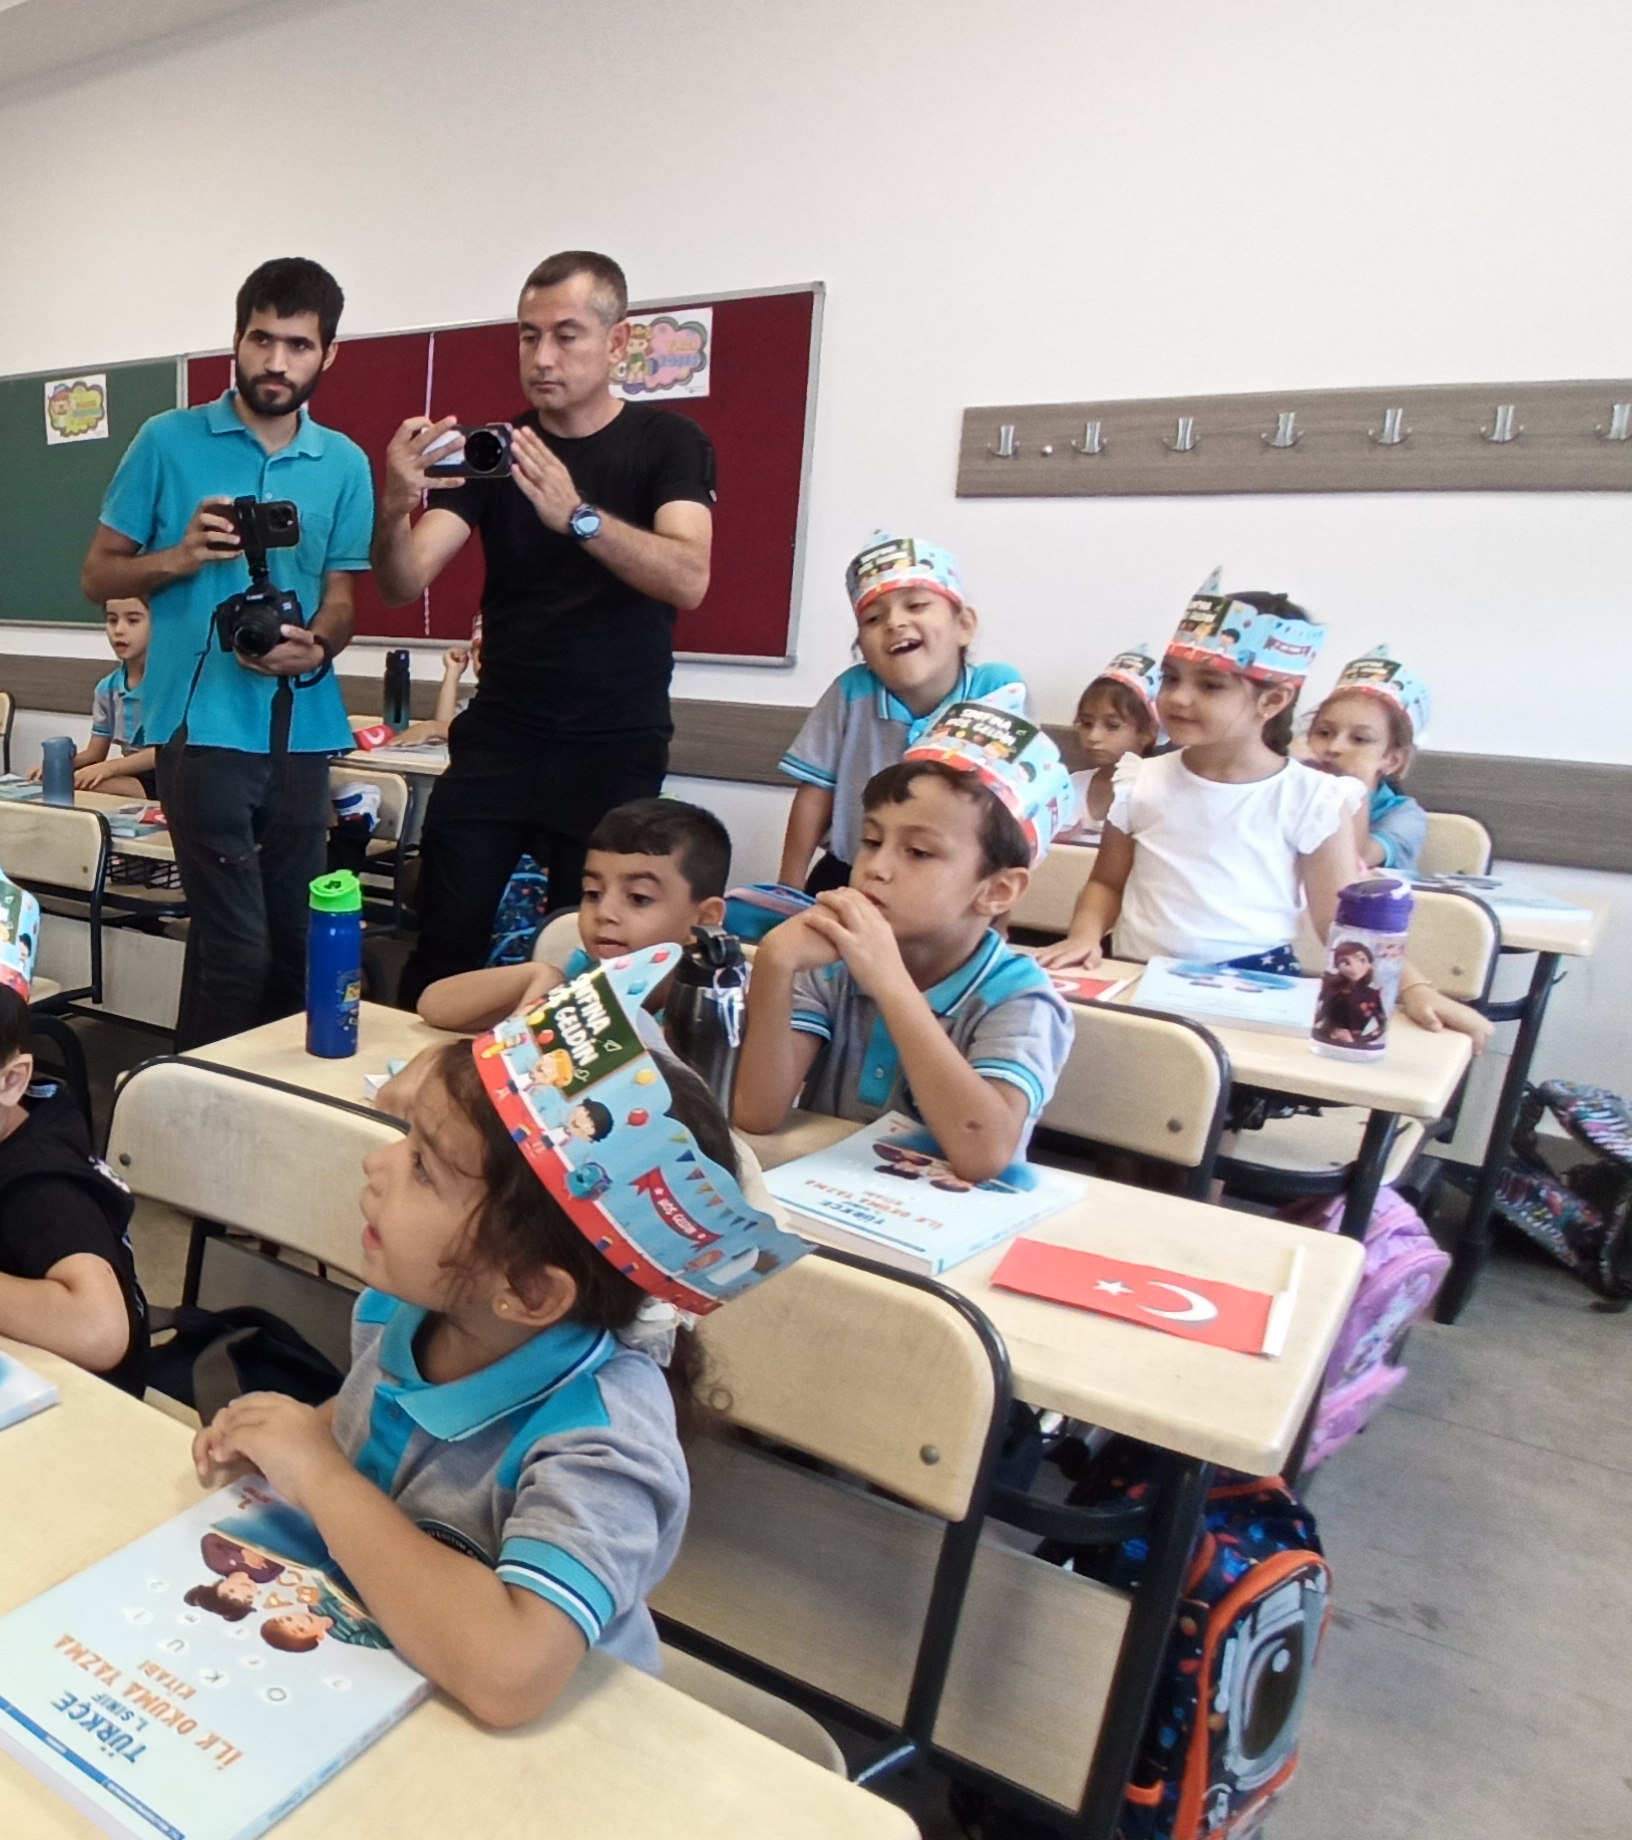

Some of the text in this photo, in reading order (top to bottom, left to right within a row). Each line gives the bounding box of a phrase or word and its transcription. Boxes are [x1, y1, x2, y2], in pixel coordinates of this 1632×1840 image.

[554, 1006, 599, 1066] GELDİN
[53, 1633, 123, 1688] YAZMA
[137, 1658, 198, 1701] KİTABI
[50, 1690, 148, 1764] TÜRKÇE
[122, 1680, 198, 1736] OKUMA
[195, 1731, 245, 1771] İLK
